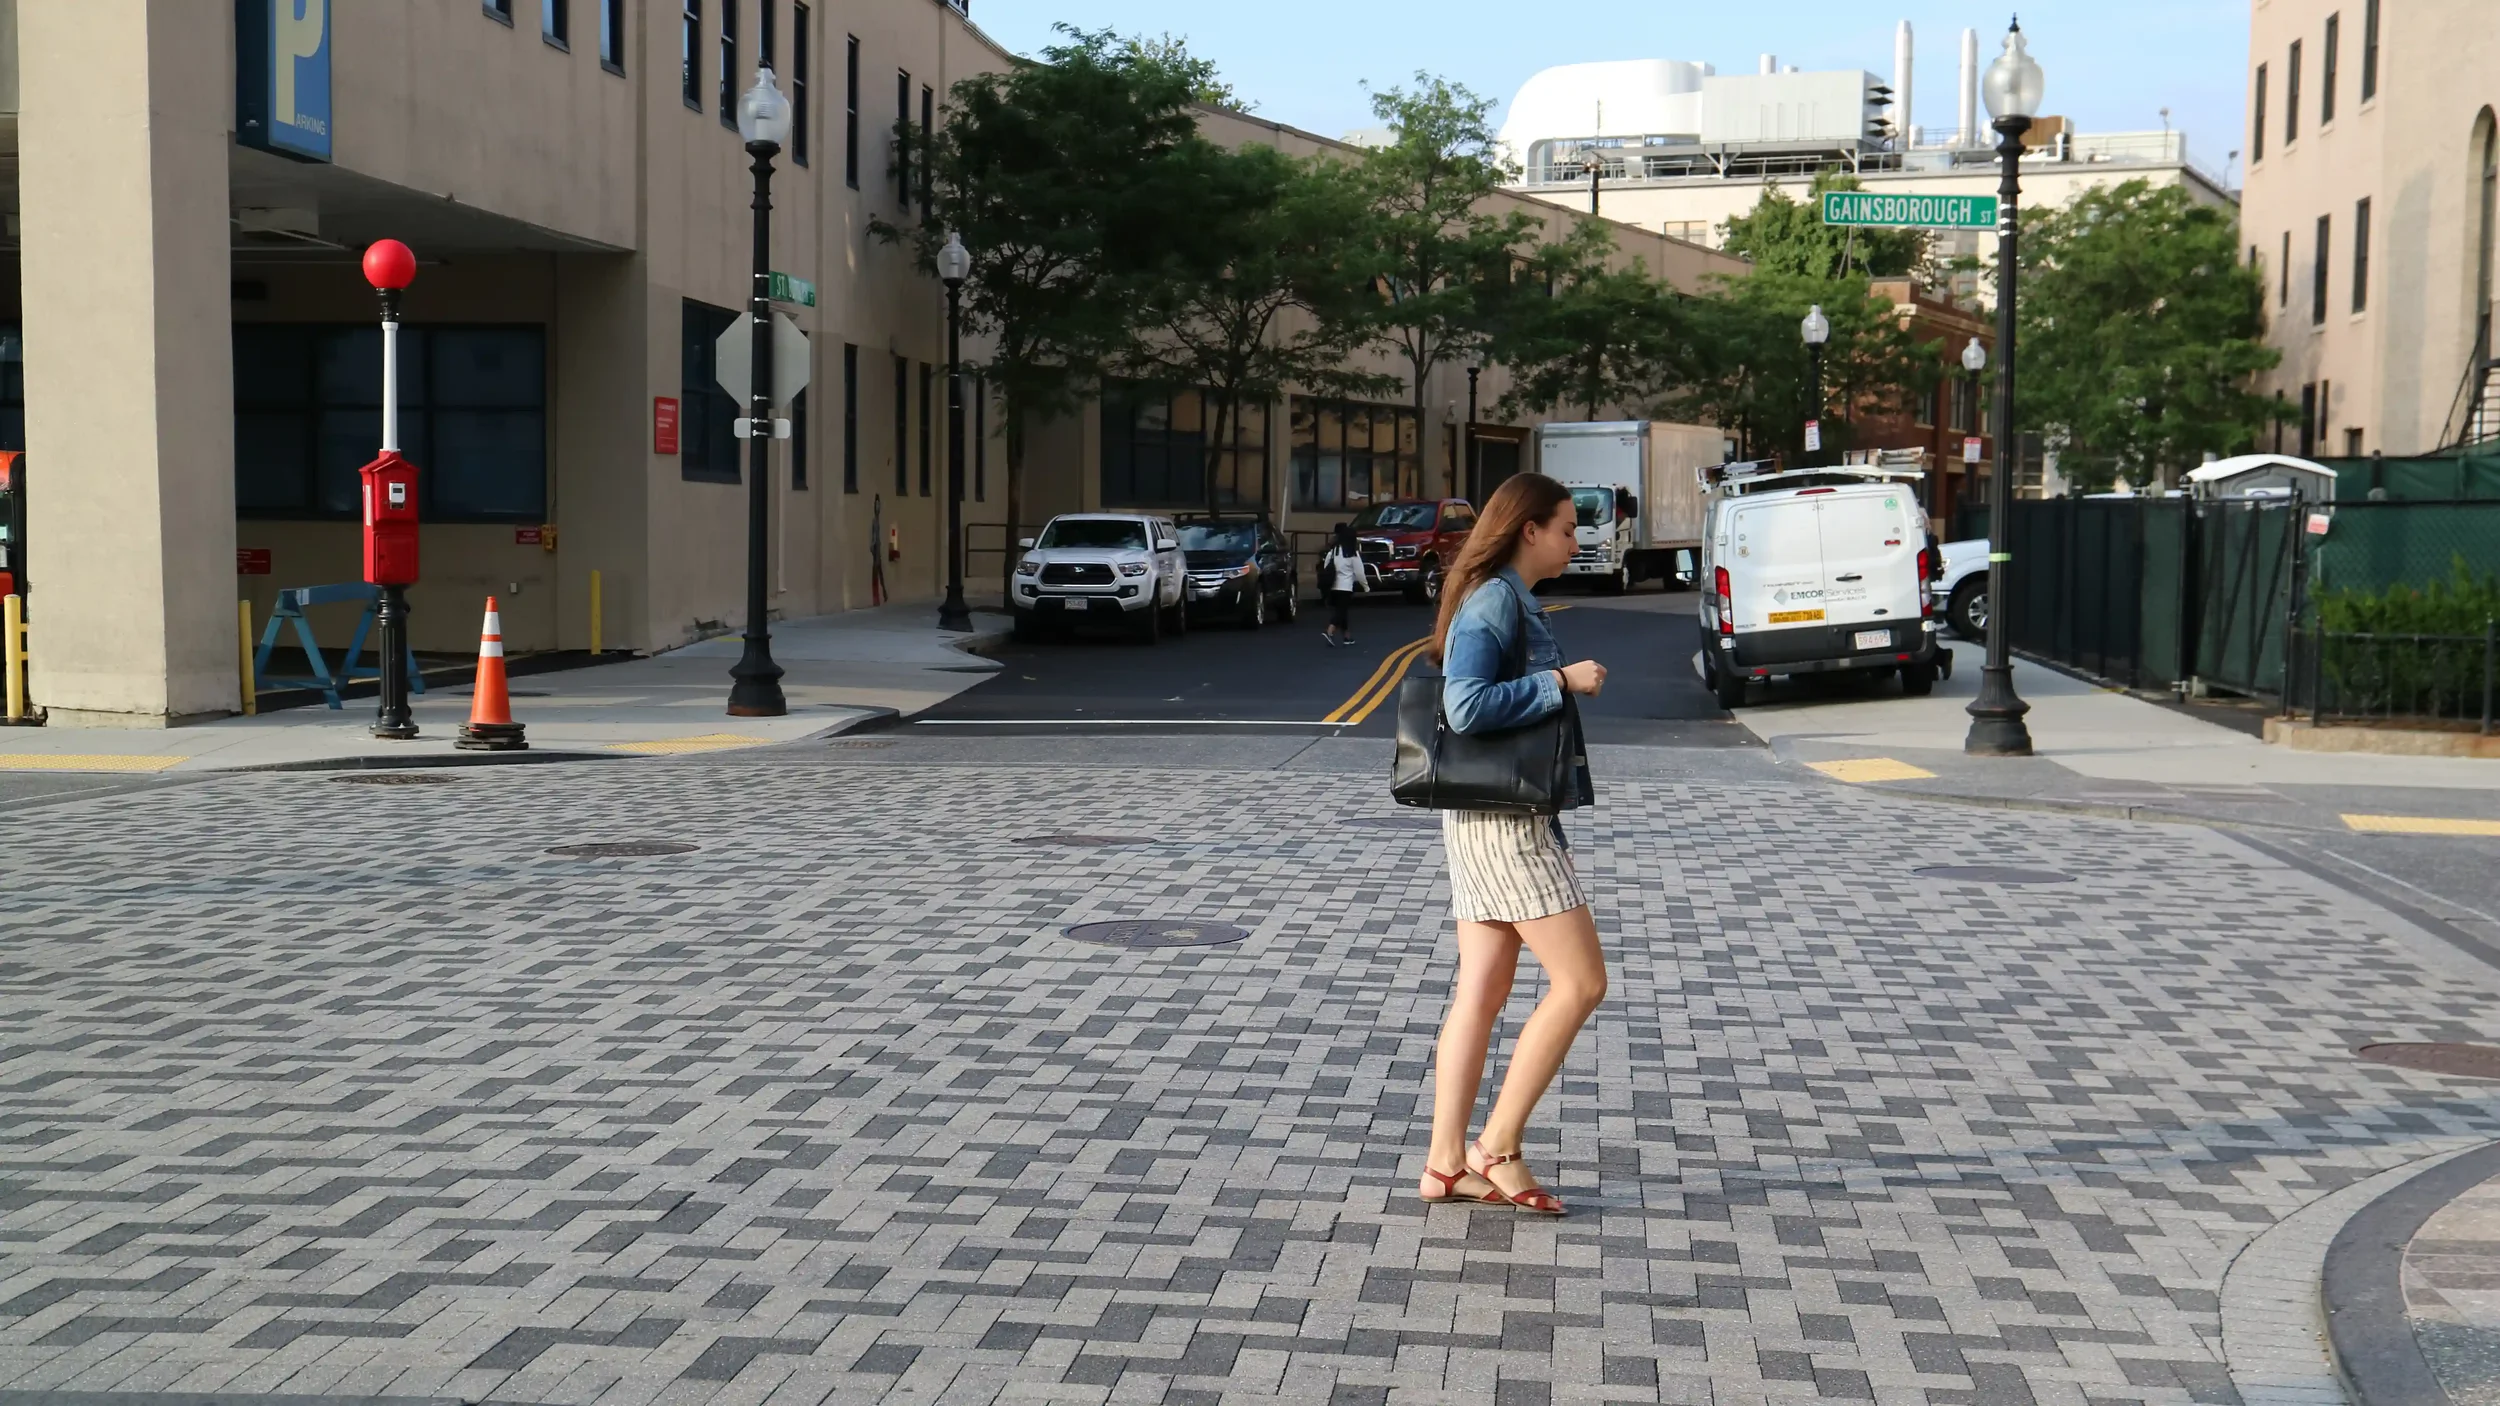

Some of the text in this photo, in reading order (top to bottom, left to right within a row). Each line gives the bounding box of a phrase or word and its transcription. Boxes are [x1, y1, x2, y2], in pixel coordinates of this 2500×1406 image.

[1829, 196, 1993, 224] GAINSBOROUGH ST
[1790, 589, 1824, 600] EMCOR
[1826, 588, 1866, 597] Services
